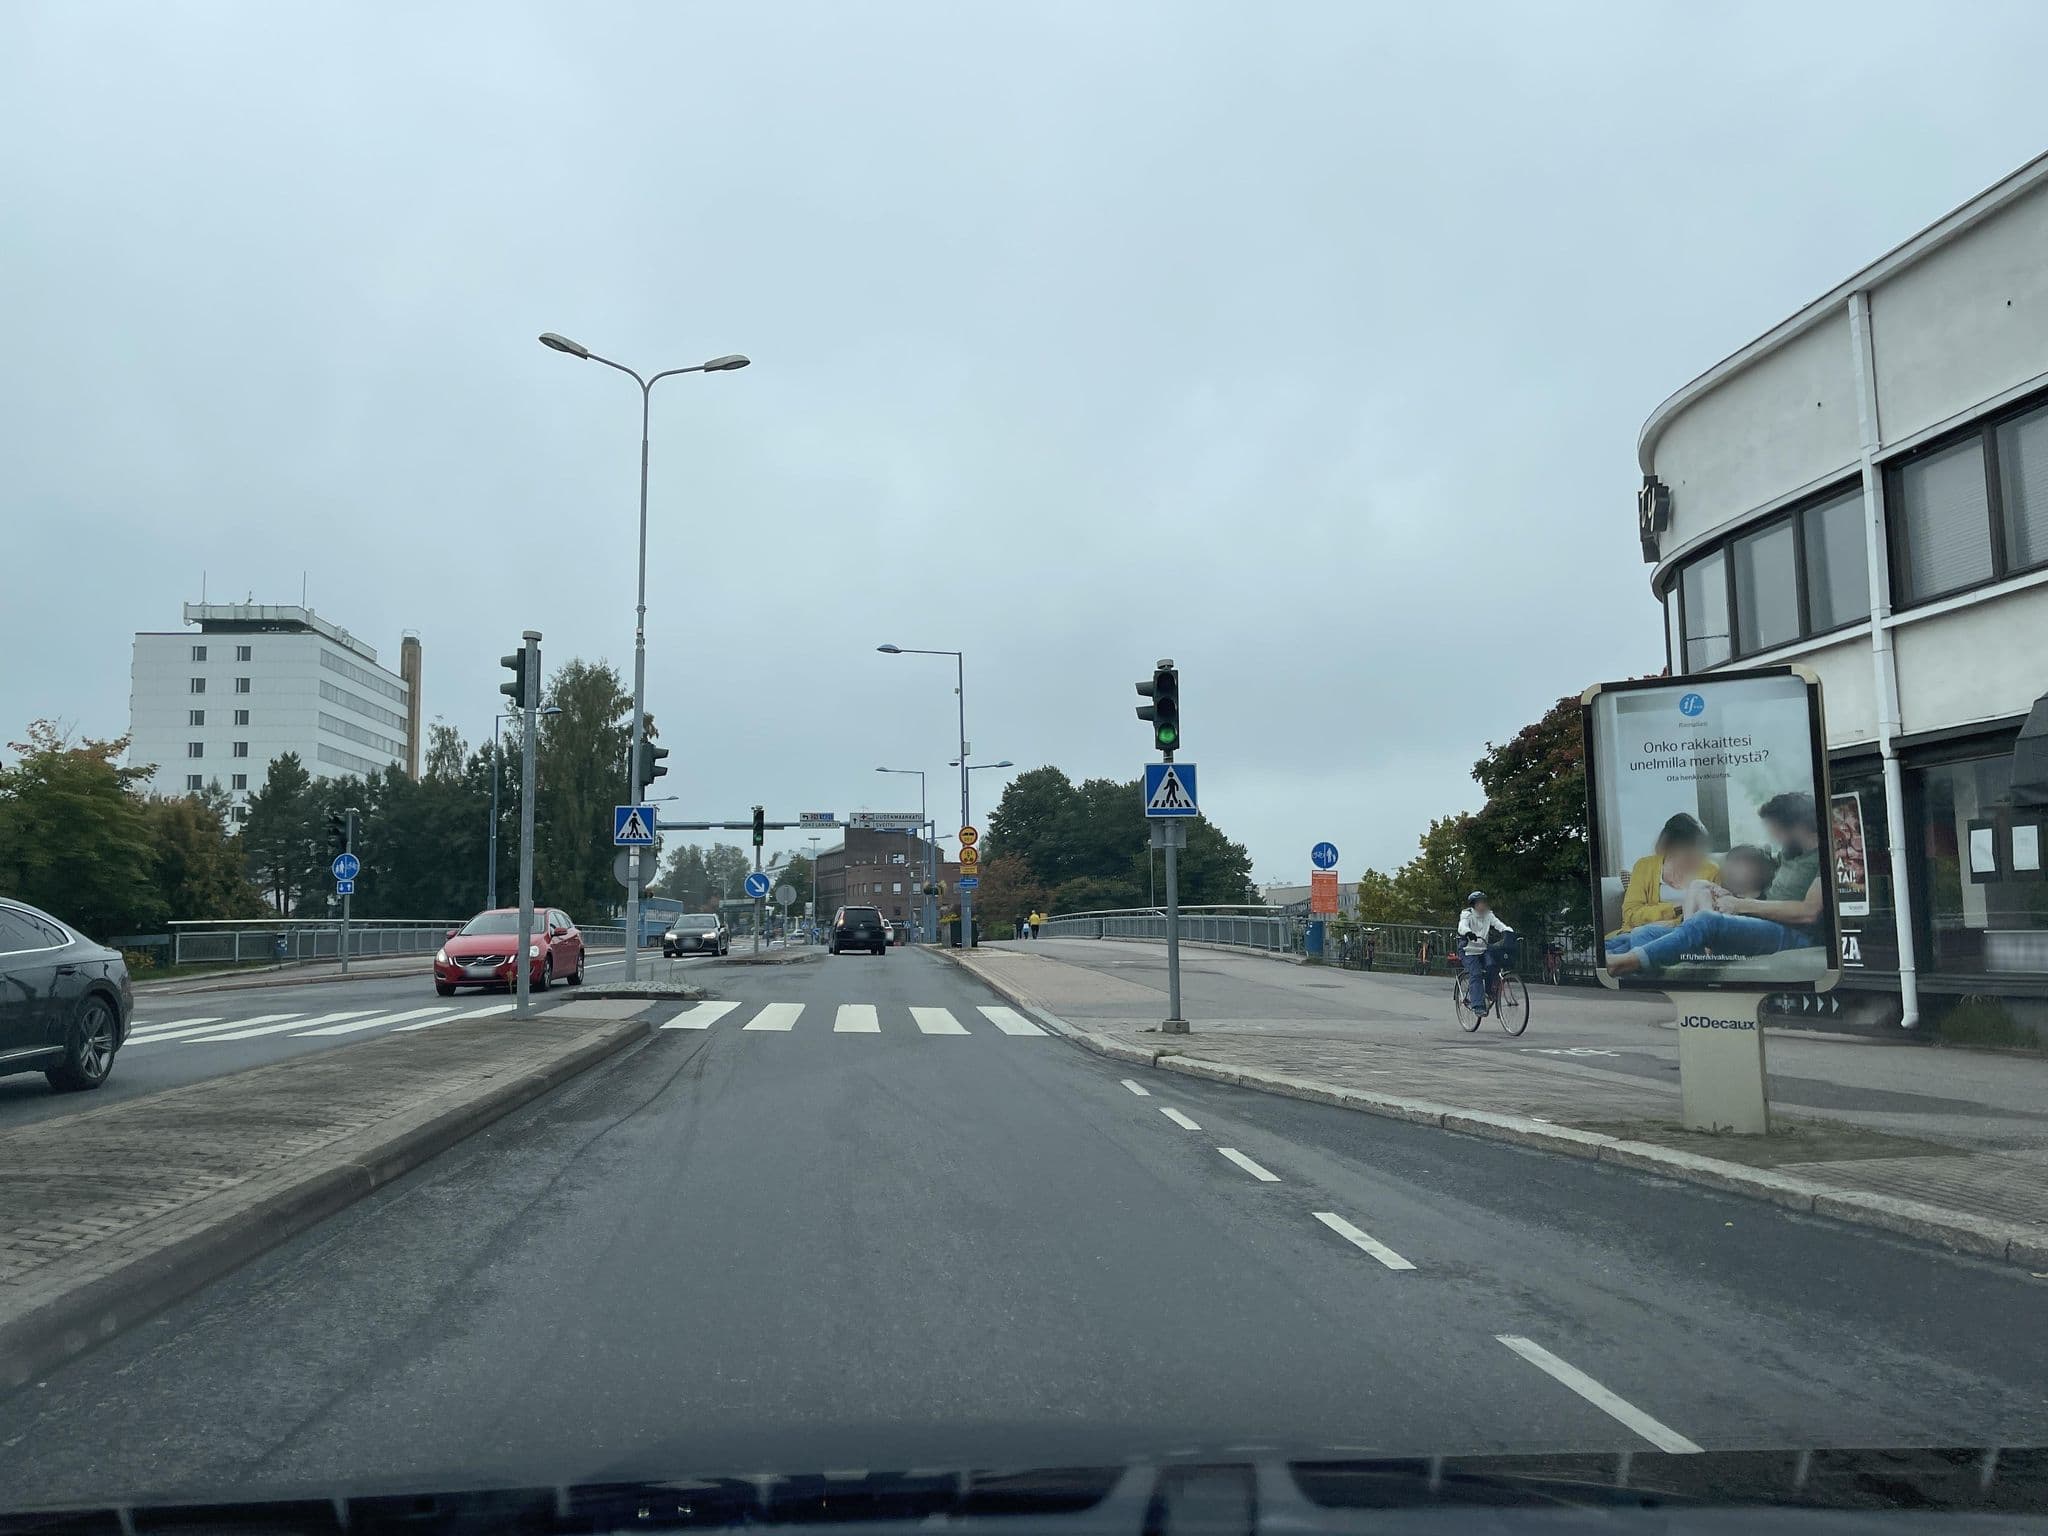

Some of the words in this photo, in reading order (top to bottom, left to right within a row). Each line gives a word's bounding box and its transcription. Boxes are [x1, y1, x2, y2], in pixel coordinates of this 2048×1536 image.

[1643, 741, 1678, 753] Onko
[1681, 734, 1752, 751] rakkaittesi
[1630, 756, 1686, 771] unelmilla
[1689, 749, 1769, 767] merkitystä?
[1666, 774, 1679, 782] Ota
[1680, 1015, 1756, 1031] JCDecaux
